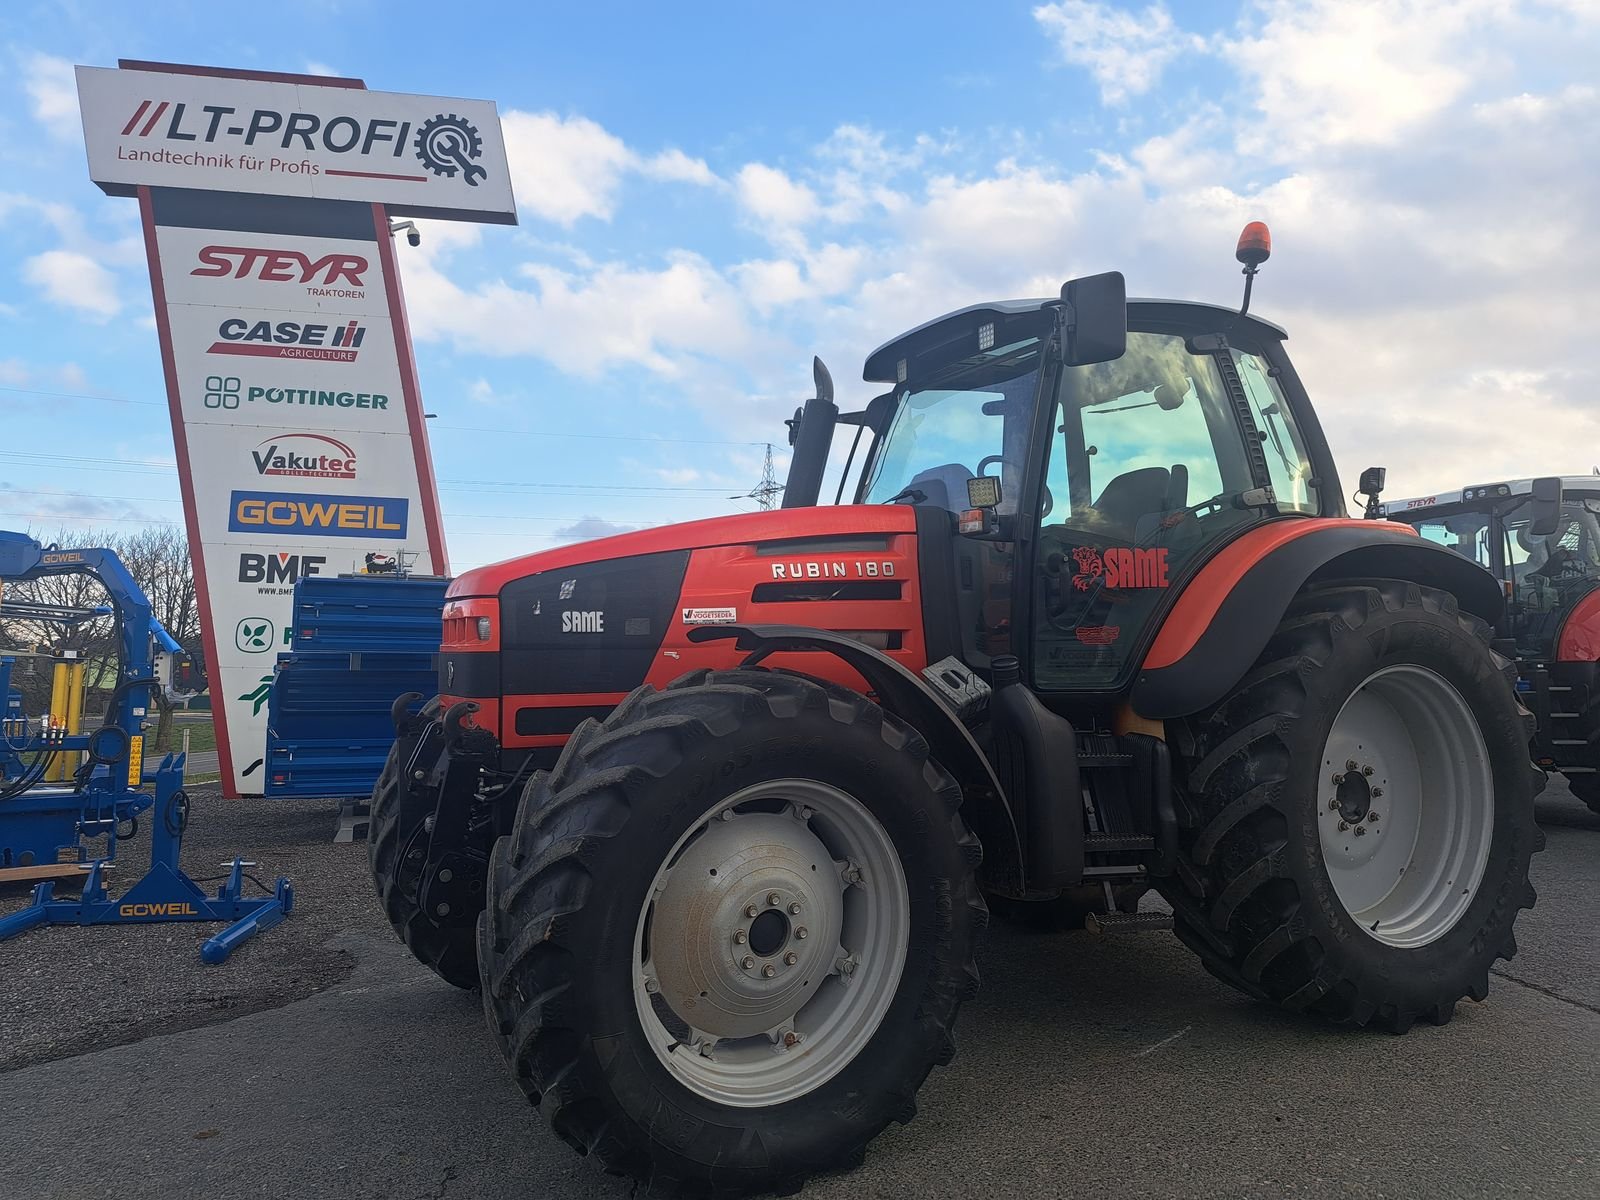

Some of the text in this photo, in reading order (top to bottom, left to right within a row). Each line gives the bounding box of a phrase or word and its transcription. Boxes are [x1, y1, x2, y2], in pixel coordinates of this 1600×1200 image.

[118, 146, 320, 176] Landtechnik für Profis
[190, 245, 369, 287] STEYR
[307, 287, 366, 299] TRAKTOREN
[218, 318, 328, 346] CASE
[280, 348, 353, 361] AGRICULTURE
[251, 445, 357, 475] Vakutec
[1407, 496, 1436, 509] STEYR
[238, 552, 327, 585] BMF
[771, 561, 895, 578] RUBIN 180
[1103, 547, 1169, 589] SAME
[562, 611, 604, 632] SAME
